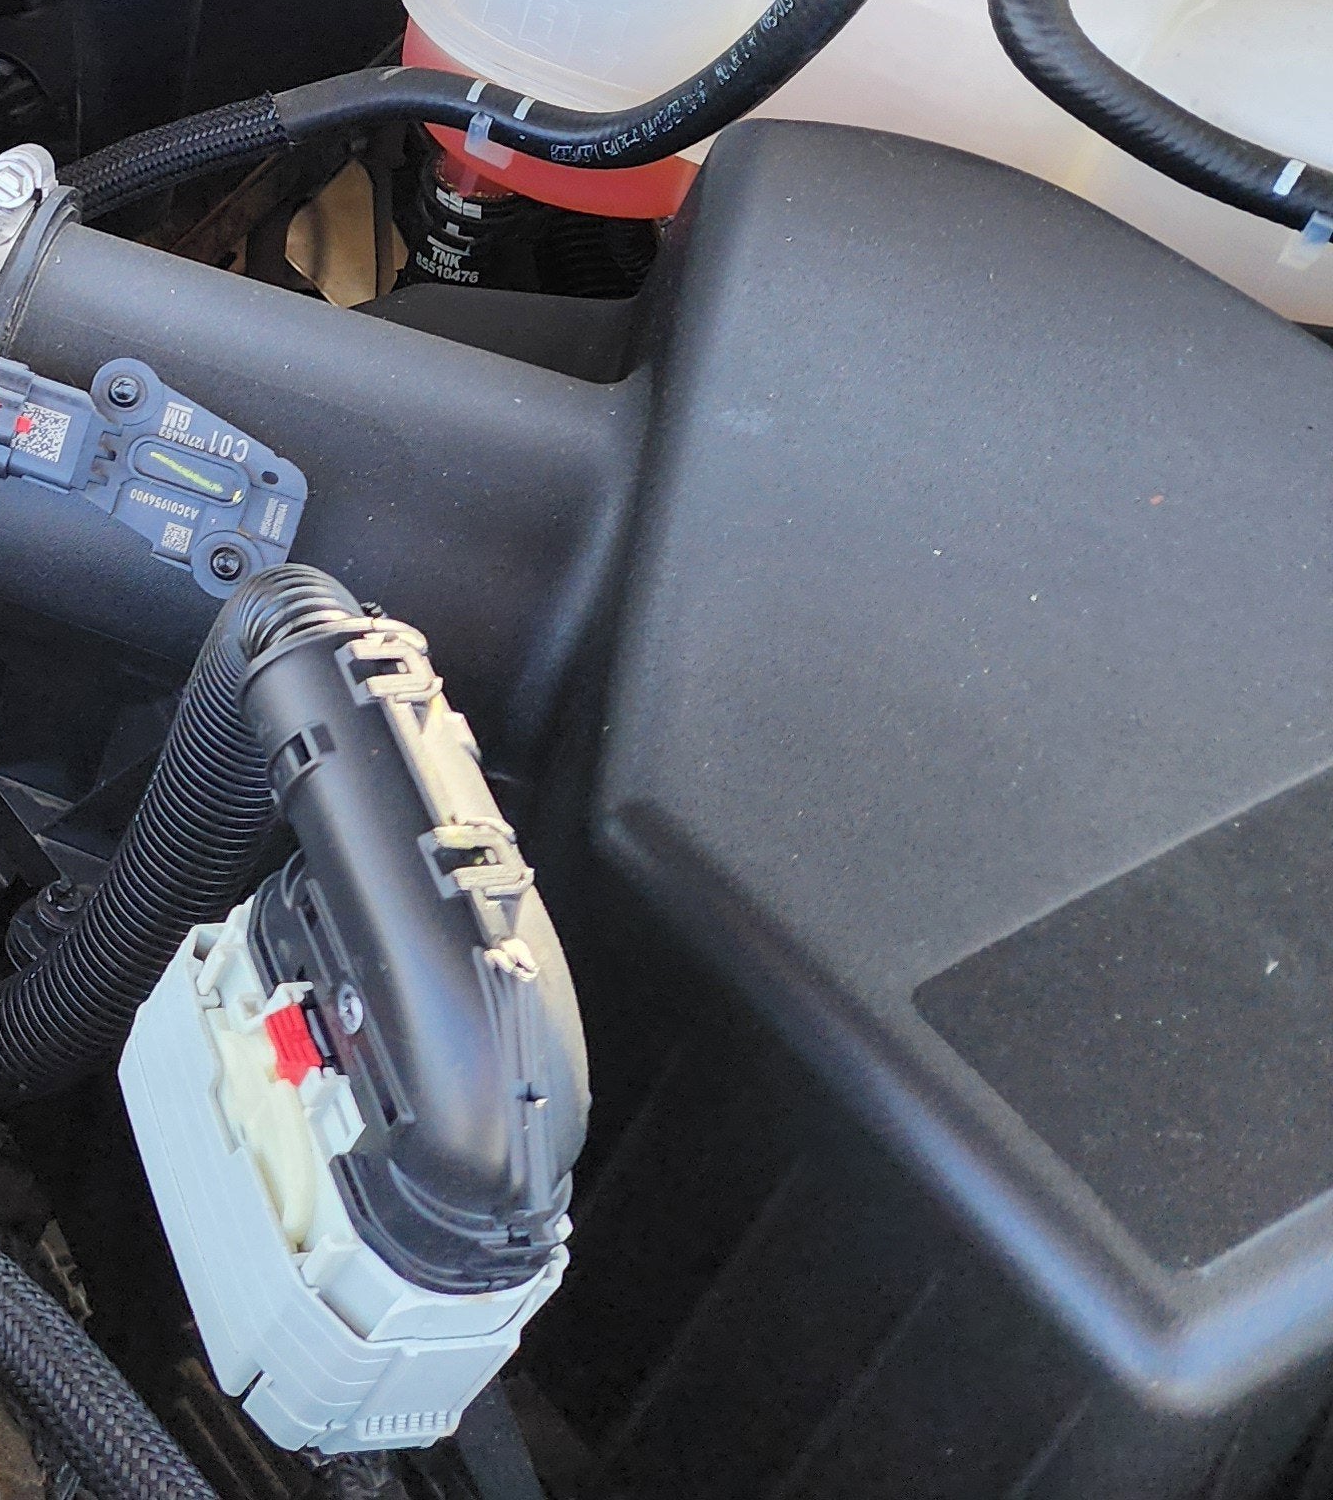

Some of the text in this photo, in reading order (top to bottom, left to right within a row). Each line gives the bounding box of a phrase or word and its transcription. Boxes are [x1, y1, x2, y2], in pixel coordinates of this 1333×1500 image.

[429, 244, 462, 270] TNK
[162, 405, 193, 431] GM
[208, 430, 250, 463] C01
